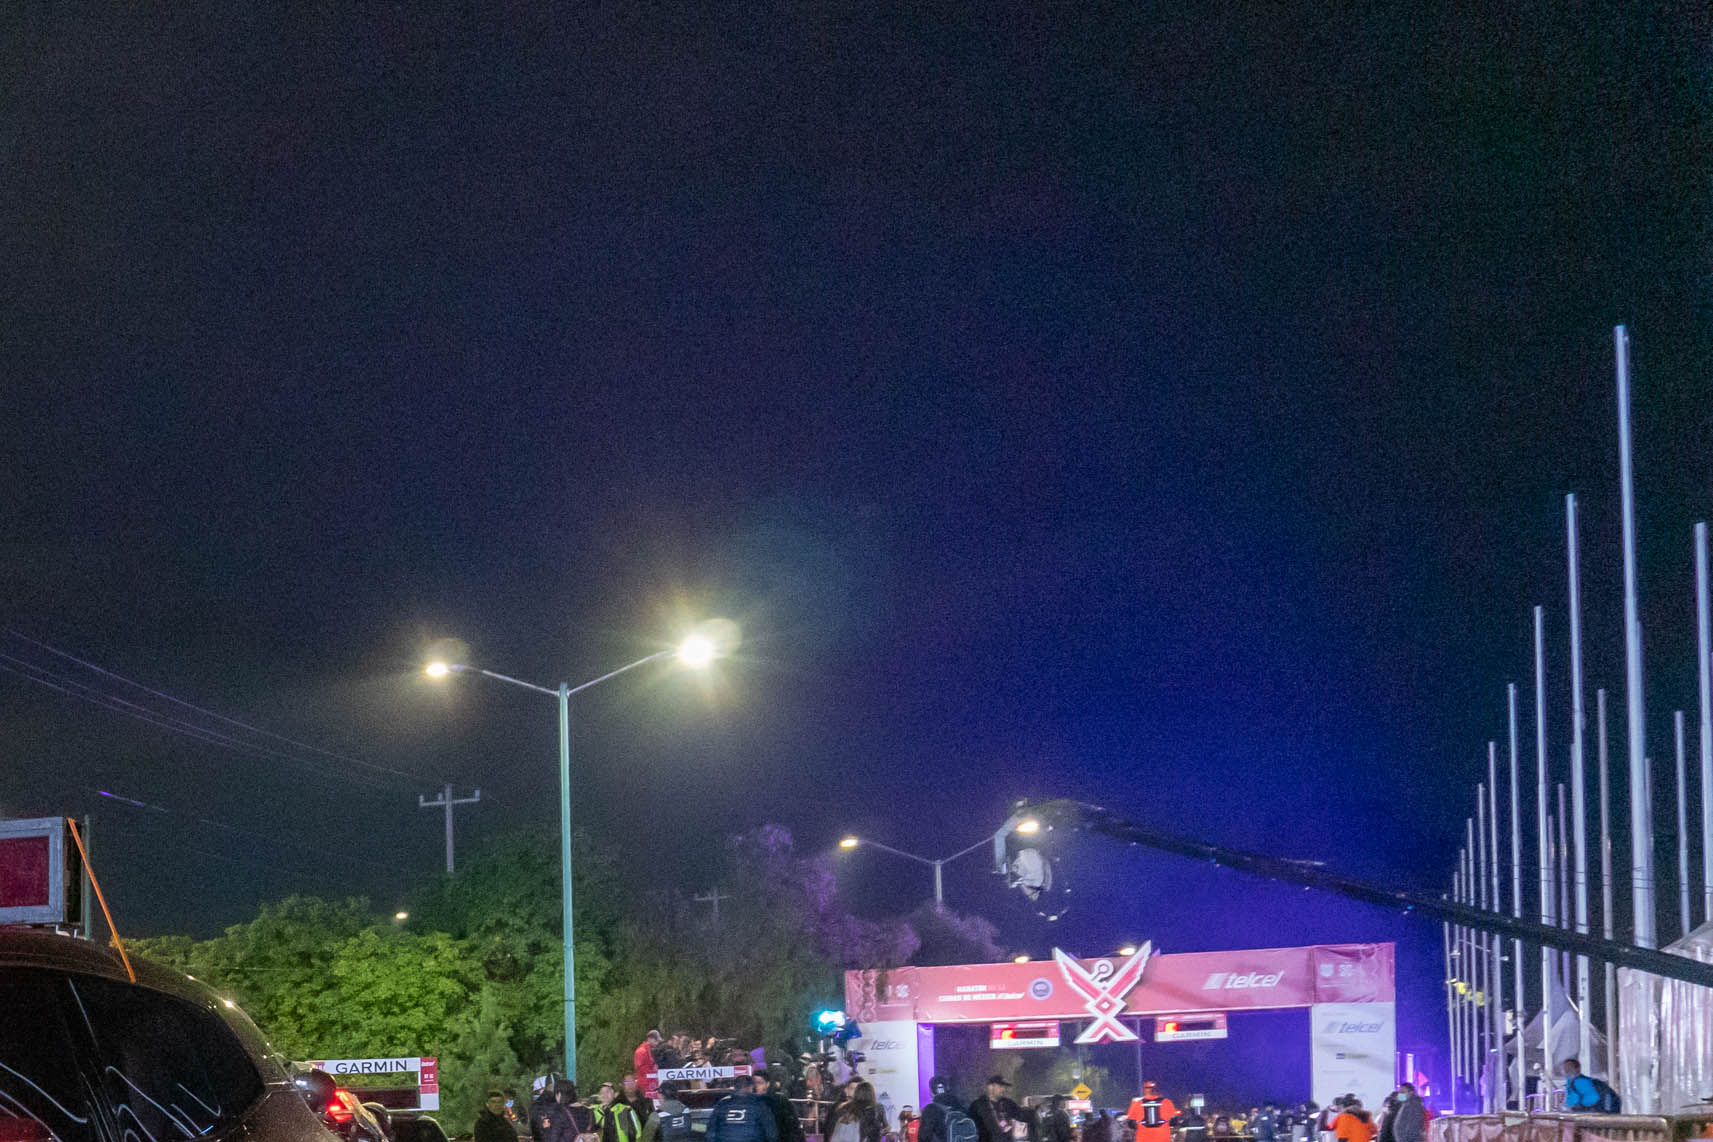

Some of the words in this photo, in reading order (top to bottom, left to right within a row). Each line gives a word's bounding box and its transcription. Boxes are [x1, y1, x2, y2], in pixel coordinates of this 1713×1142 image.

[1224, 970, 1286, 989] telcel
[335, 1060, 407, 1074] GARMIN
[666, 1068, 723, 1080] GARMIN
